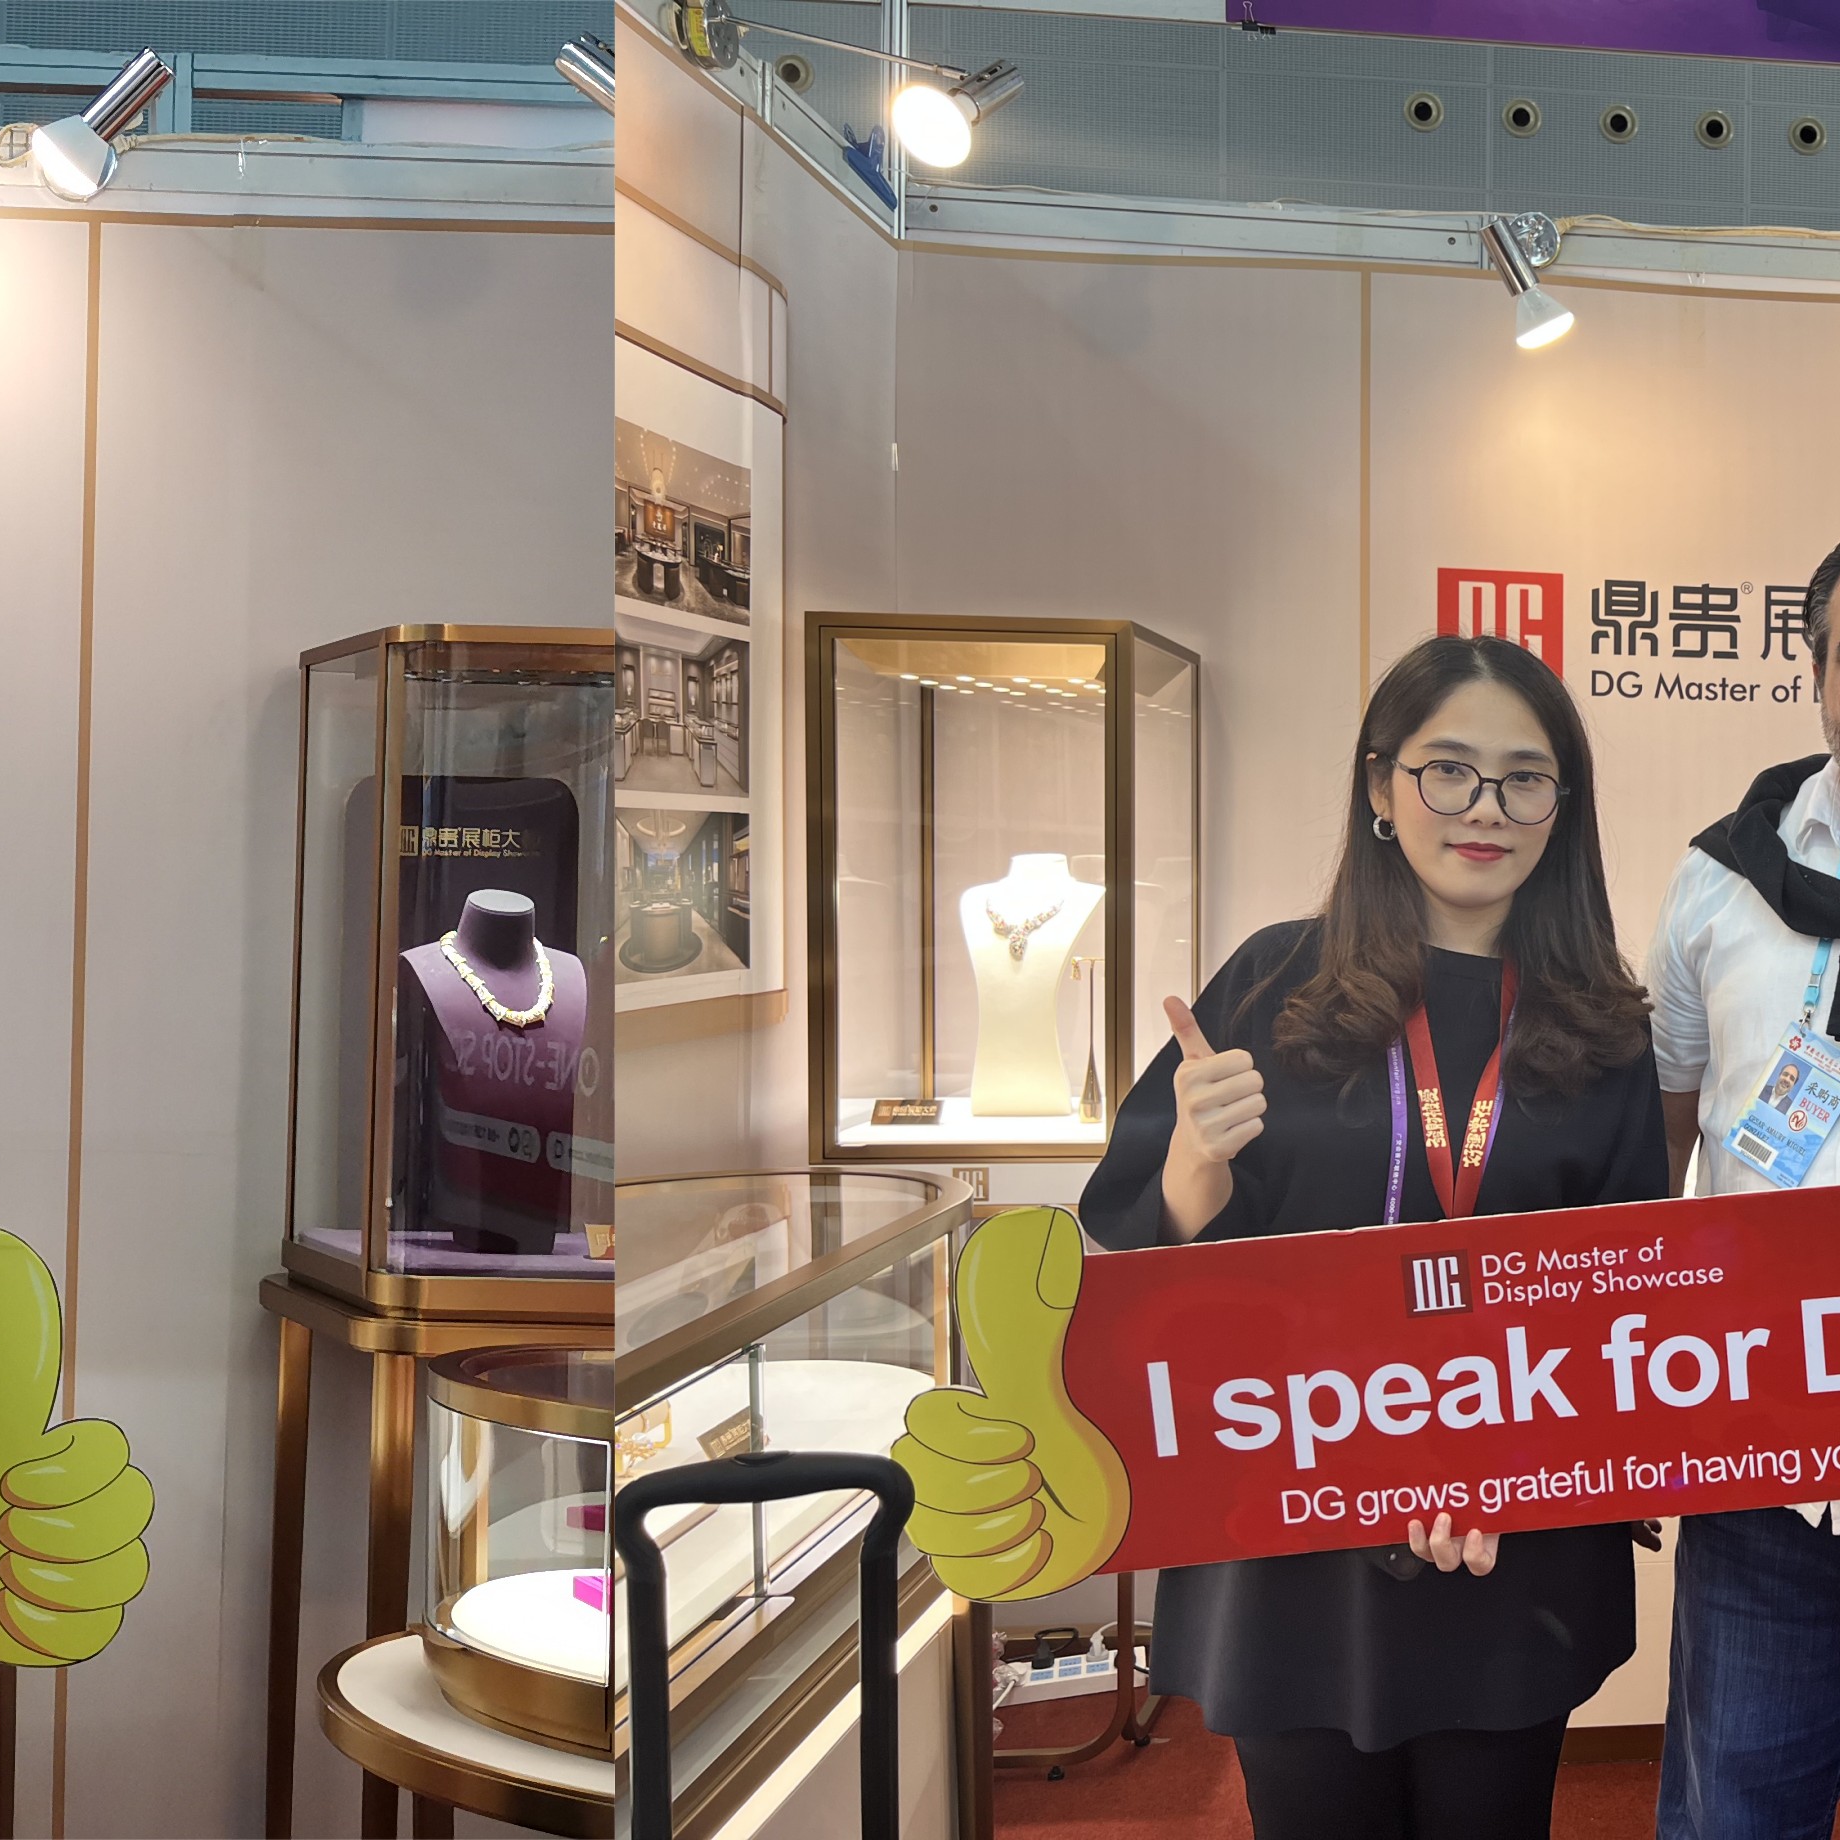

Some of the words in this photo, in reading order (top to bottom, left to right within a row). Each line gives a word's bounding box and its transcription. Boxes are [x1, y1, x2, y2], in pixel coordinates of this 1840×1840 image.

[1591, 669, 1643, 698] DG
[1654, 671, 1761, 703] Master
[1770, 674, 1802, 703] of
[1799, 1097, 1831, 1124] BUYER
[1480, 1251, 1528, 1278] DG
[1535, 1245, 1629, 1273] Master
[1637, 1237, 1665, 1263] of
[1412, 1256, 1466, 1313] DG
[1483, 1274, 1583, 1306] Display
[1591, 1266, 1725, 1294] Showcase
[1146, 1360, 1179, 1458] I
[1212, 1326, 1579, 1470] speak
[1600, 1312, 1771, 1413] for
[1280, 1485, 1347, 1525] DG
[1356, 1481, 1470, 1526] grows
[1478, 1458, 1614, 1514] grateful
[1622, 1455, 1673, 1491] for
[1680, 1445, 1802, 1484] having
